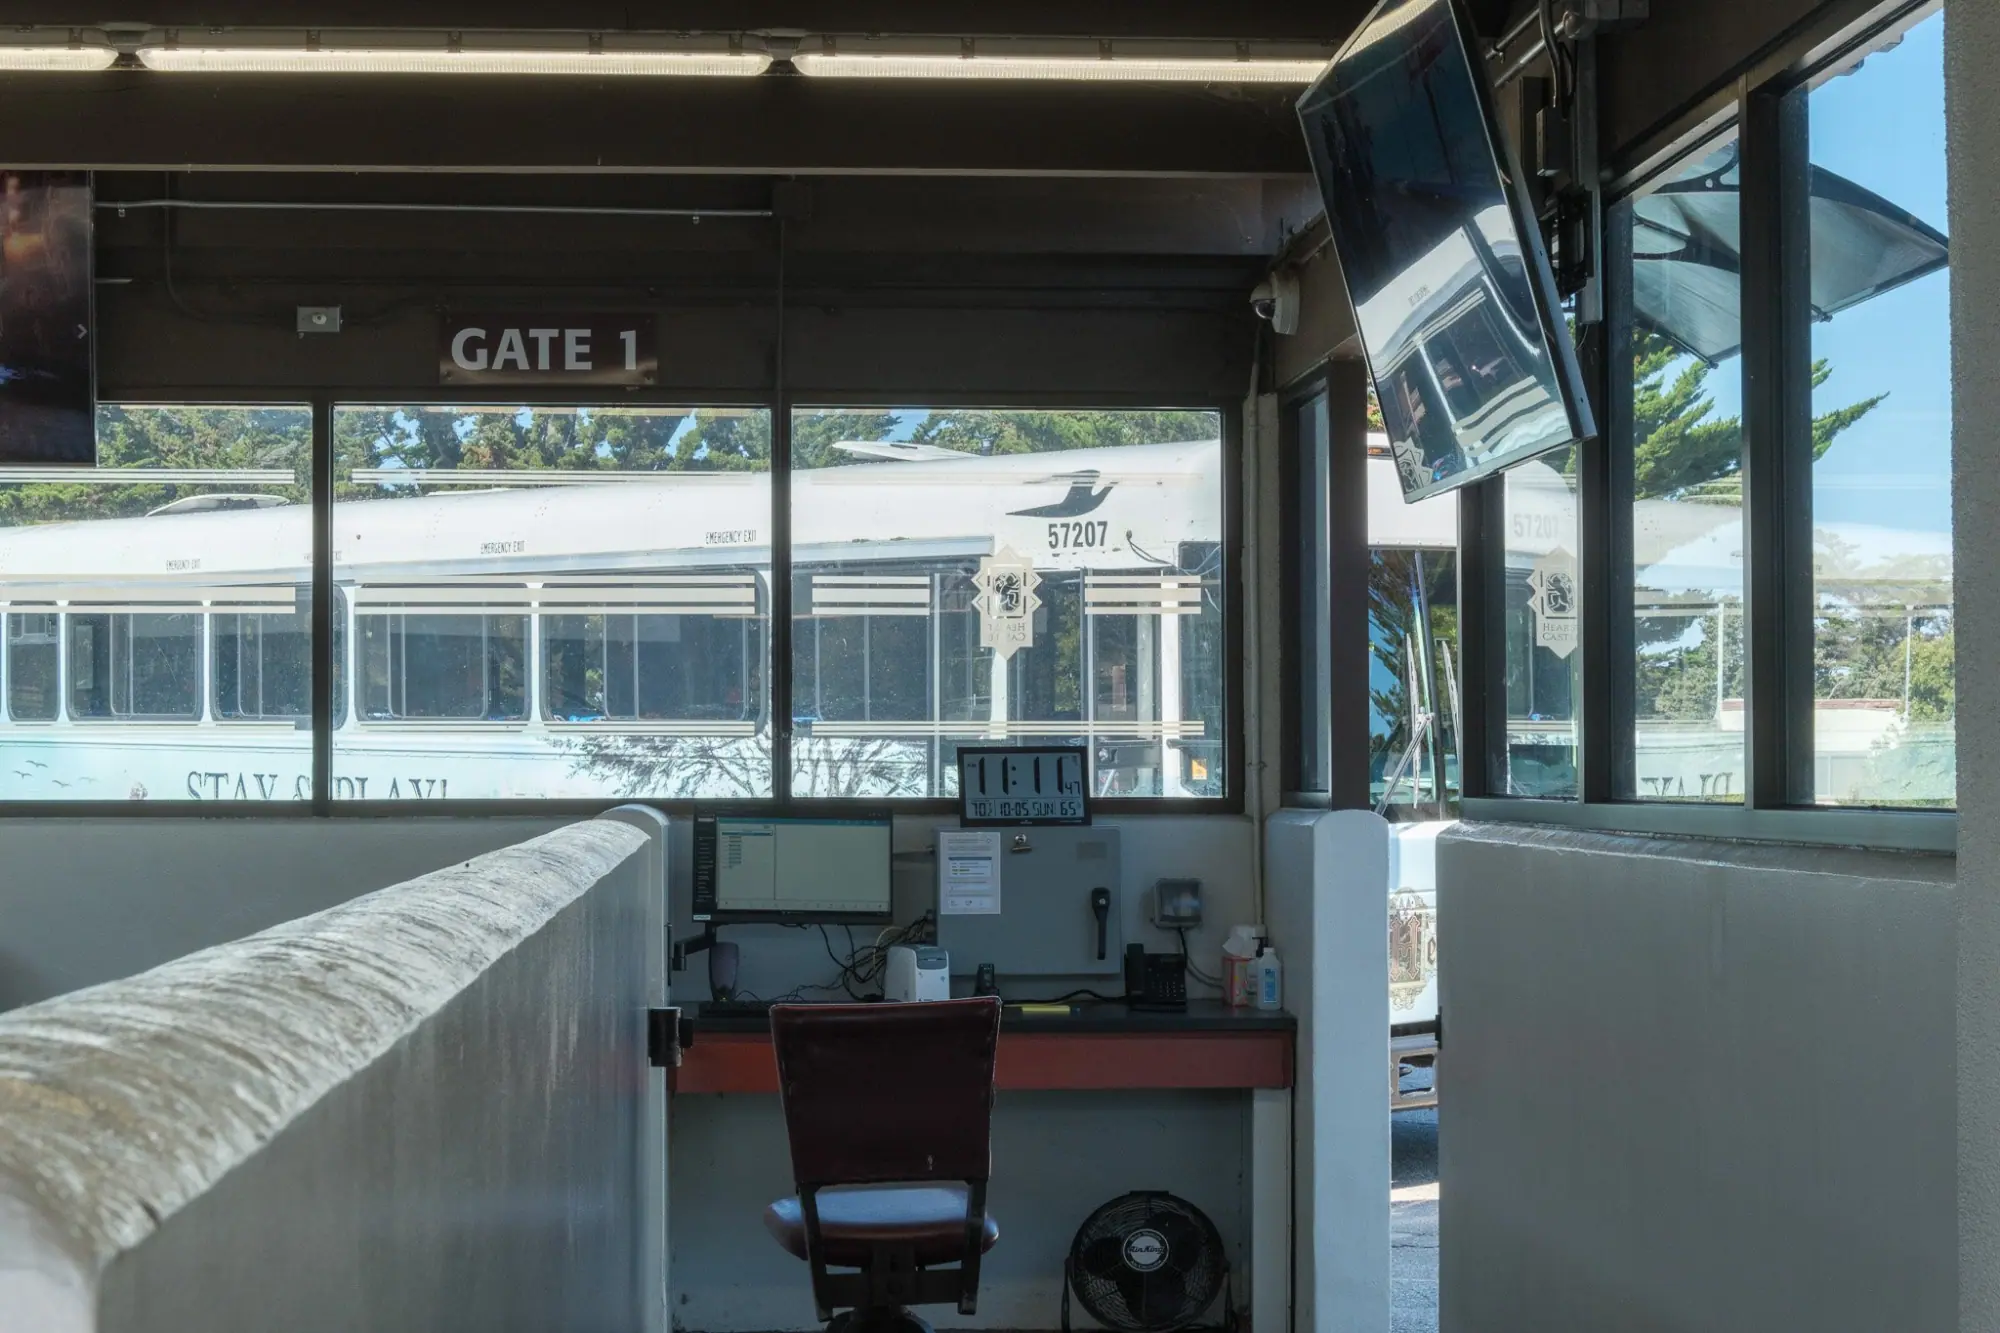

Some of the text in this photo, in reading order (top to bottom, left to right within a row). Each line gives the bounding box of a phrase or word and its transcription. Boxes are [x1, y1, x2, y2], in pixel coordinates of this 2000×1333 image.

[451, 328, 637, 371] GATE 1
[705, 530, 741, 545] EMERGENCY
[1048, 521, 1108, 549] 57207
[979, 756, 1064, 795] 11:11
[1032, 802, 1054, 817] SUN
[1060, 801, 1077, 817] 65
